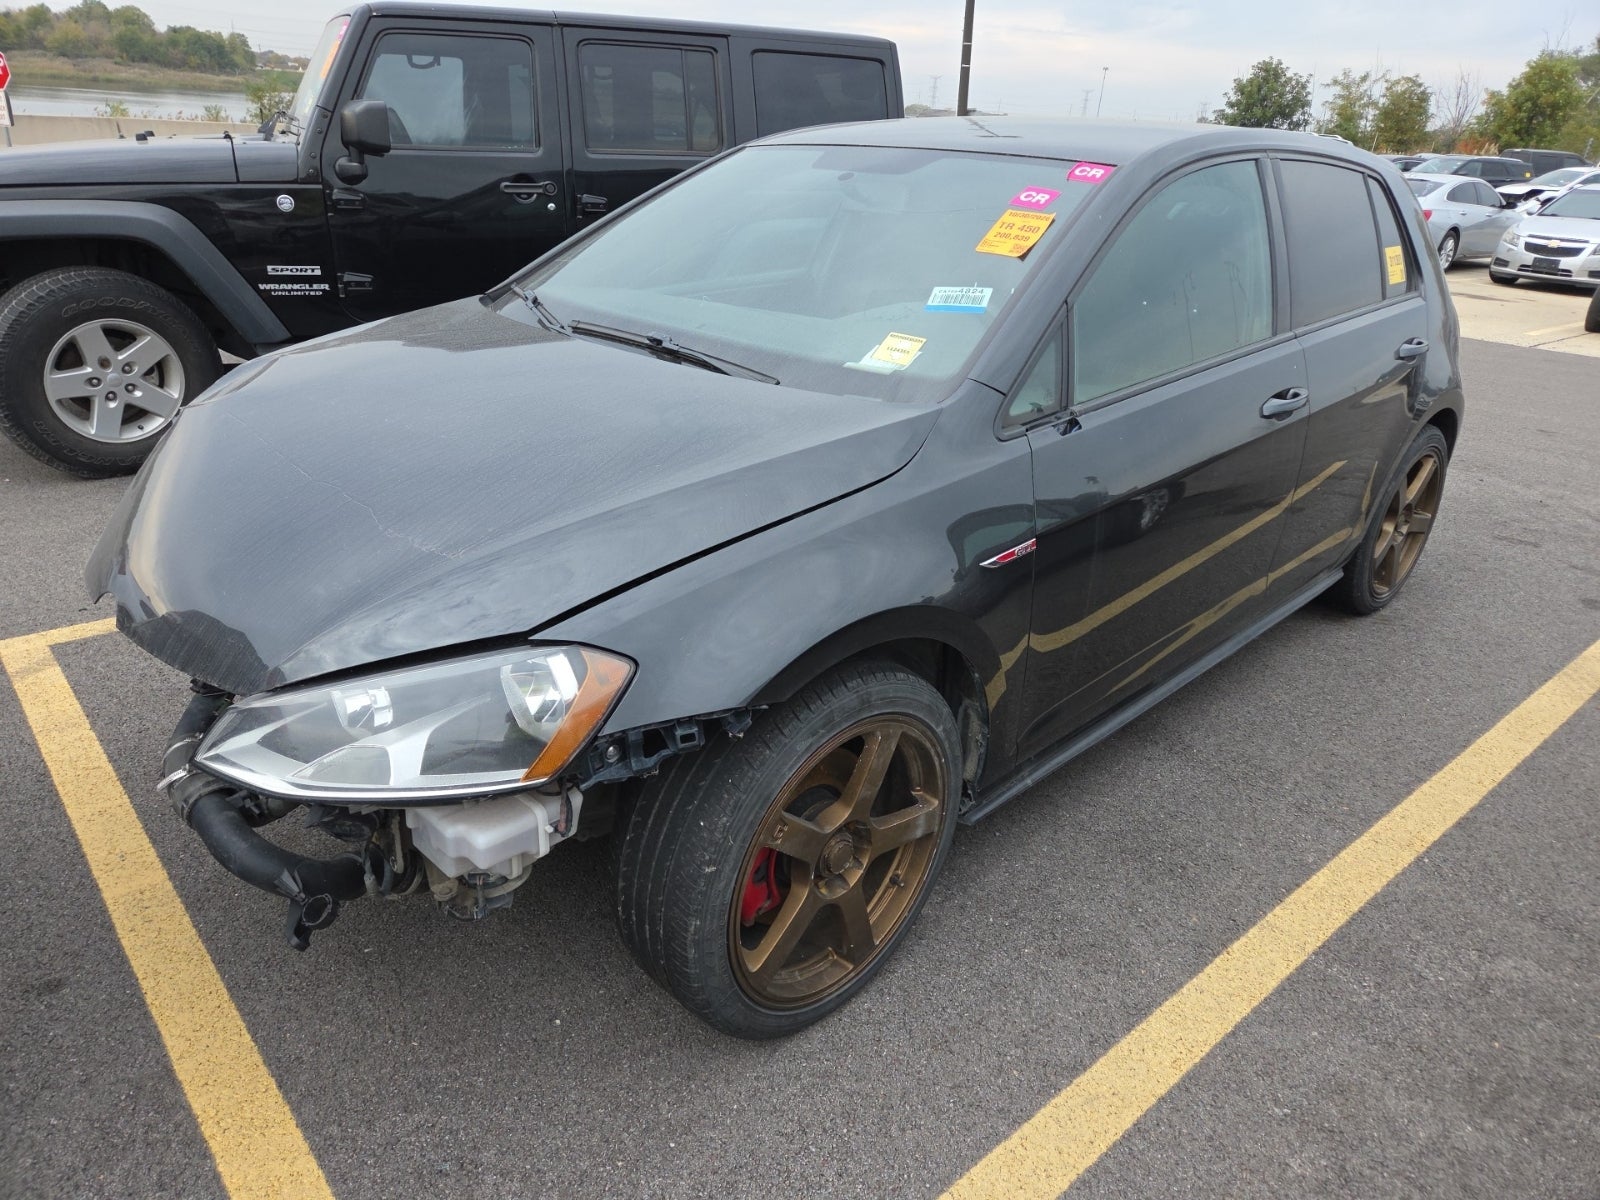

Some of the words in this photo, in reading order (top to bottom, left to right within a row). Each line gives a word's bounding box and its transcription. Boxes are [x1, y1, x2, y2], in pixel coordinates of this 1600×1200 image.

[1073, 166, 1105, 178] CR
[1020, 191, 1050, 204] CR
[1017, 223, 1041, 235] 450
[270, 266, 321, 274] SPORT
